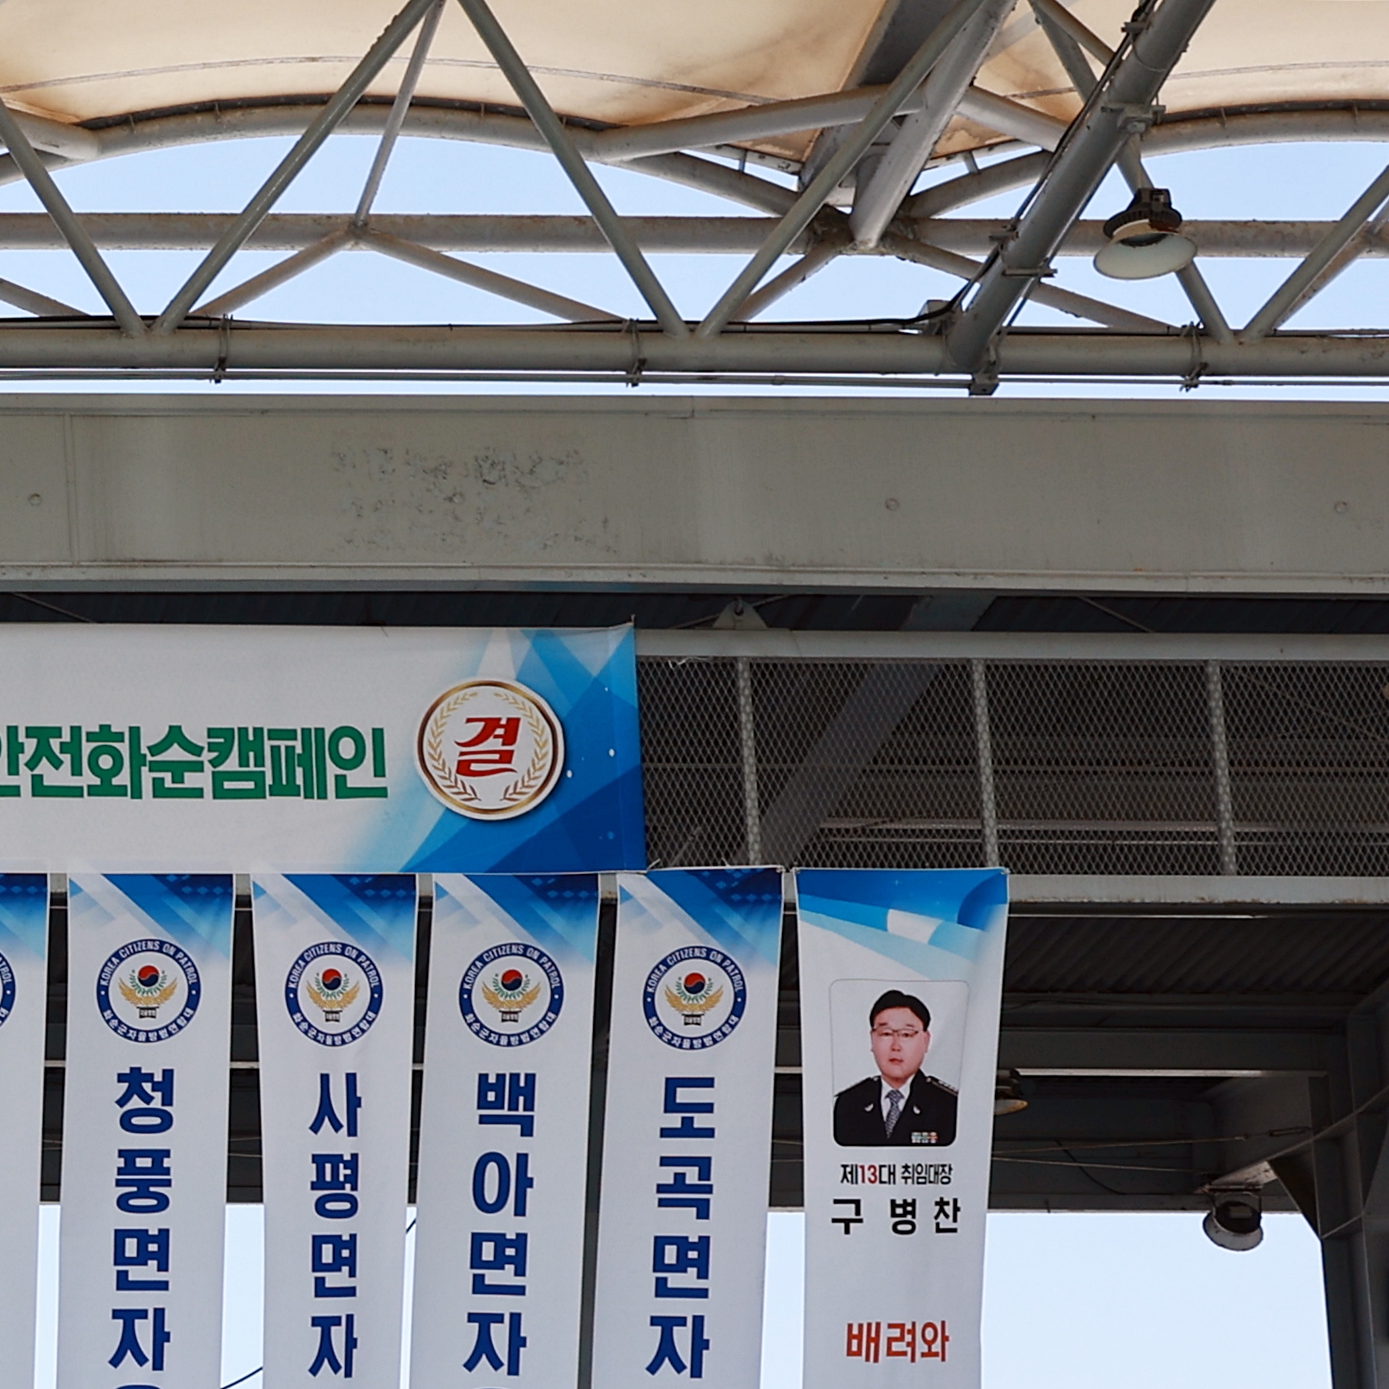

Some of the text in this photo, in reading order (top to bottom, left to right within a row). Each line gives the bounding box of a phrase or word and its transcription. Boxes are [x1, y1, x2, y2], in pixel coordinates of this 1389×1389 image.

[456, 716, 521, 777] 결
[841, 1164, 952, 1185] 제13대 취임대장
[847, 1322, 949, 1362] 배려와
